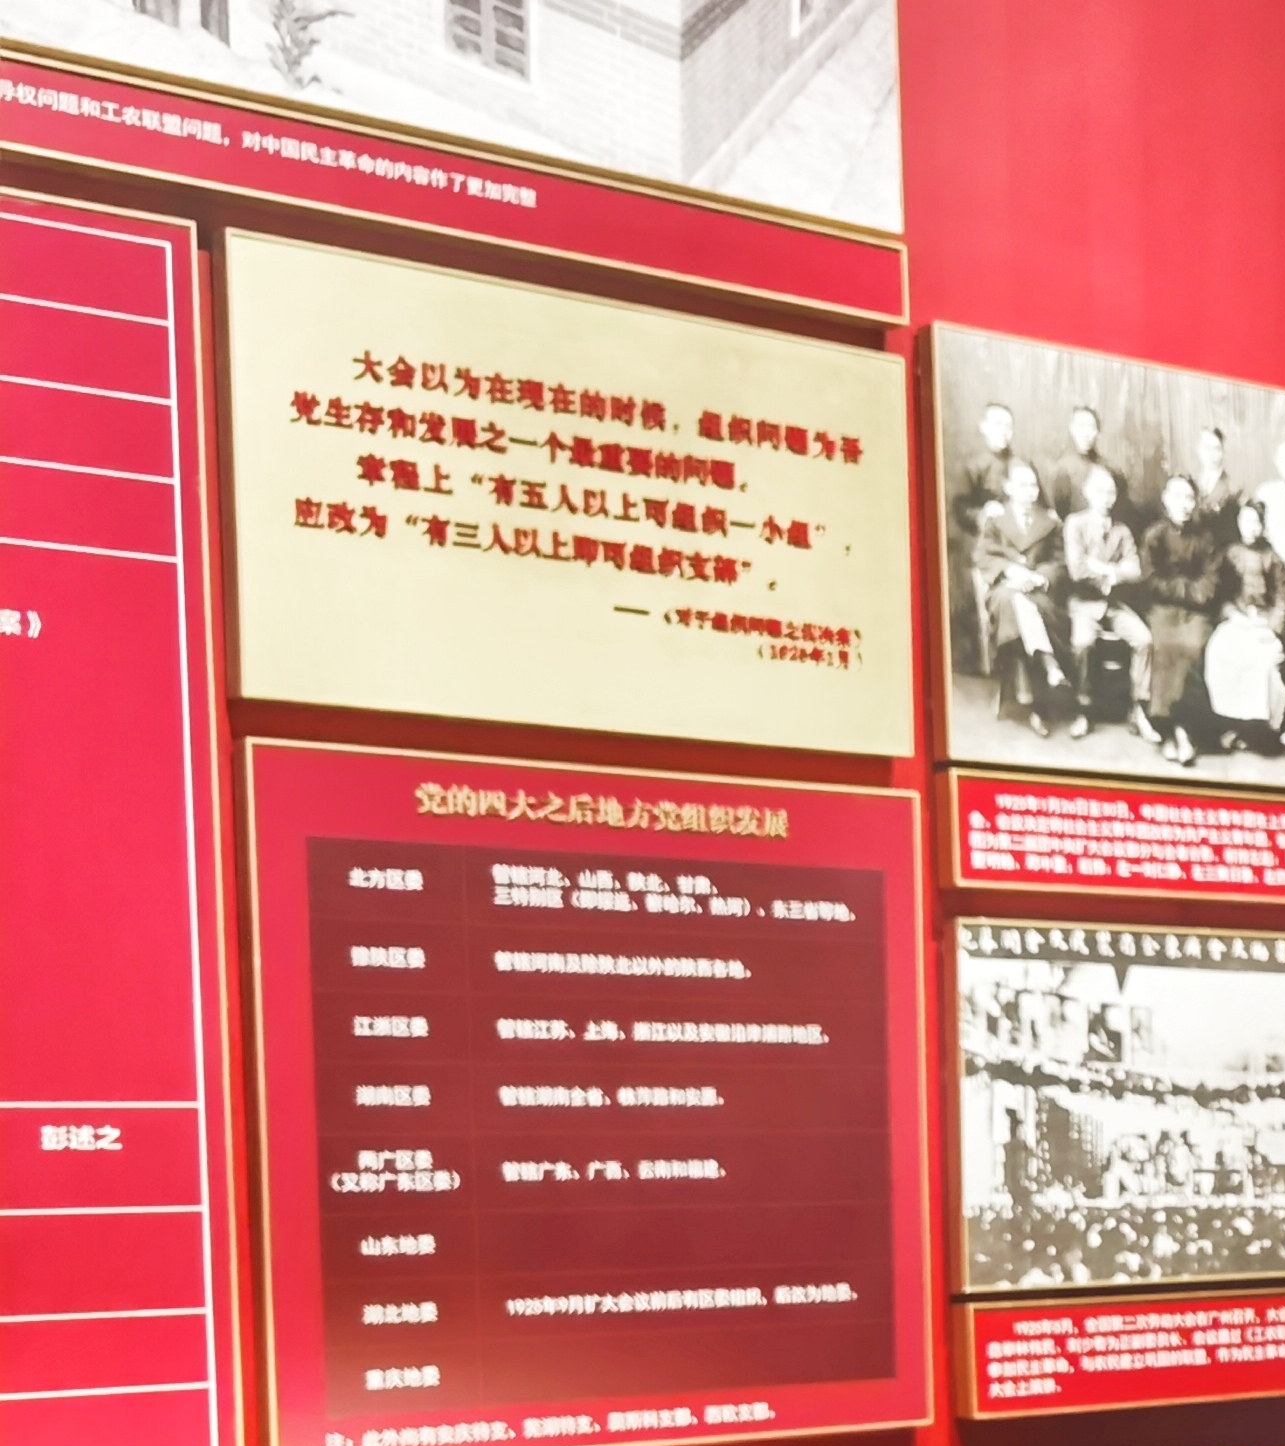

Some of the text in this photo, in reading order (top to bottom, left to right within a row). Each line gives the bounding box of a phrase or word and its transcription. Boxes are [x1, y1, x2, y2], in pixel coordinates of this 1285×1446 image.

[414, 781, 789, 840] 党的四大之后地方党组织发展
[40, 1124, 123, 1152] 彭述之
